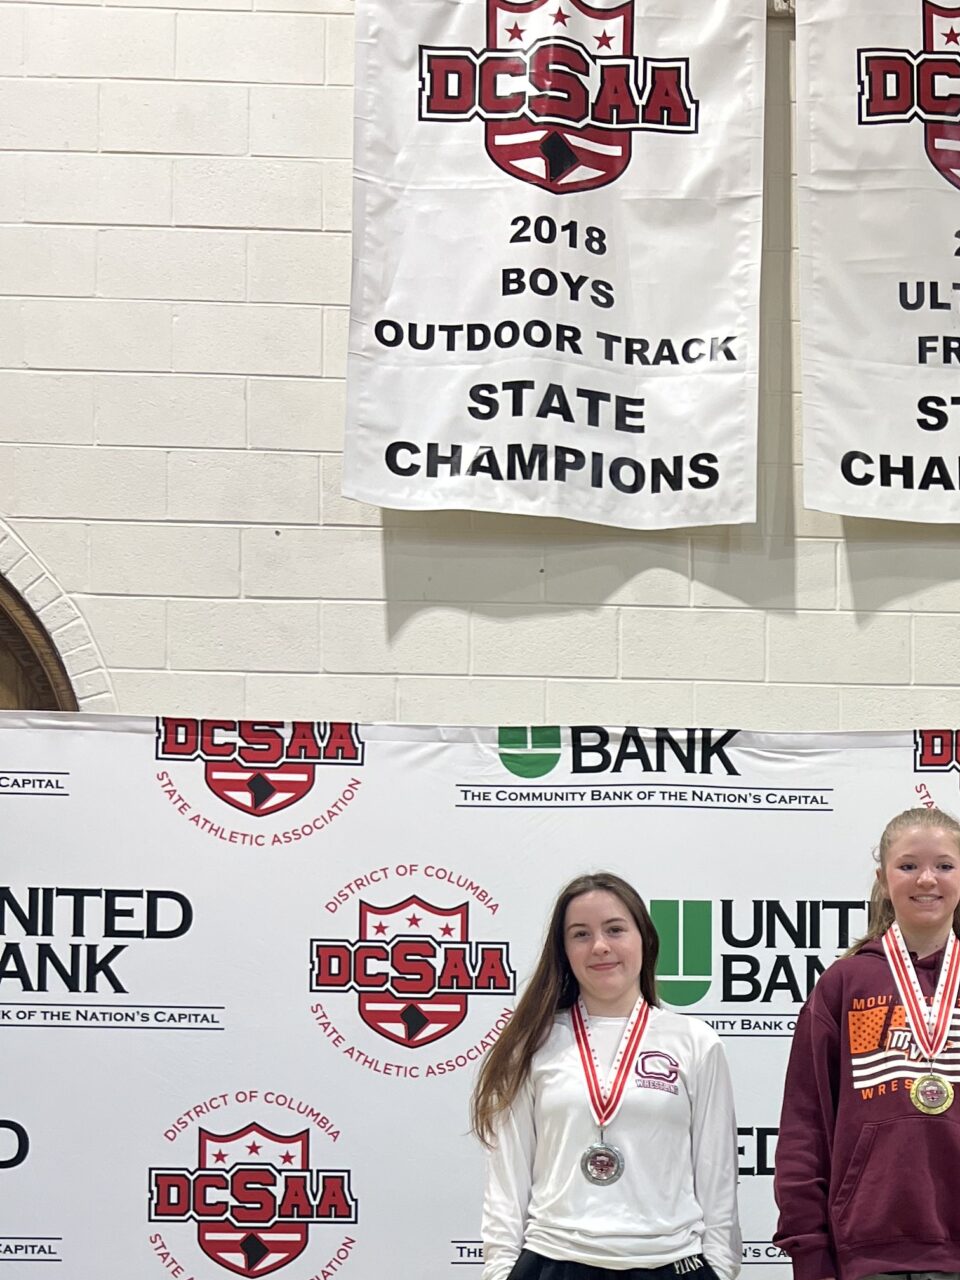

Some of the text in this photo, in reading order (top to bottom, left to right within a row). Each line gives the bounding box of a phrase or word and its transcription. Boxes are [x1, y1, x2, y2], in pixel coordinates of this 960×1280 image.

[418, 37, 698, 133] DCSAA
[509, 215, 607, 256] 2018
[501, 267, 615, 309] BOYS
[374, 319, 738, 365] OUTDOOR TRACK
[467, 379, 645, 434] STATE
[384, 442, 720, 494] CHAMPIONS
[155, 716, 364, 767] DCSAA
[570, 726, 741, 776] BANK
[155, 770, 362, 848] STATE ATHLETIC ASSOCIATION
[325, 864, 500, 915] DISTRICT OF COLUMBIA
[720, 900, 871, 949] UNIT
[310, 934, 516, 996] DCSAA
[311, 1003, 514, 1078] STATE ATHLETIC ASSOCIATION
[636, 1051, 679, 1083] C
[163, 1091, 341, 1142] DISTRICT OF COLUMBIA
[148, 1163, 358, 1228] DCSAA
[150, 1233, 184, 1278] STATE
